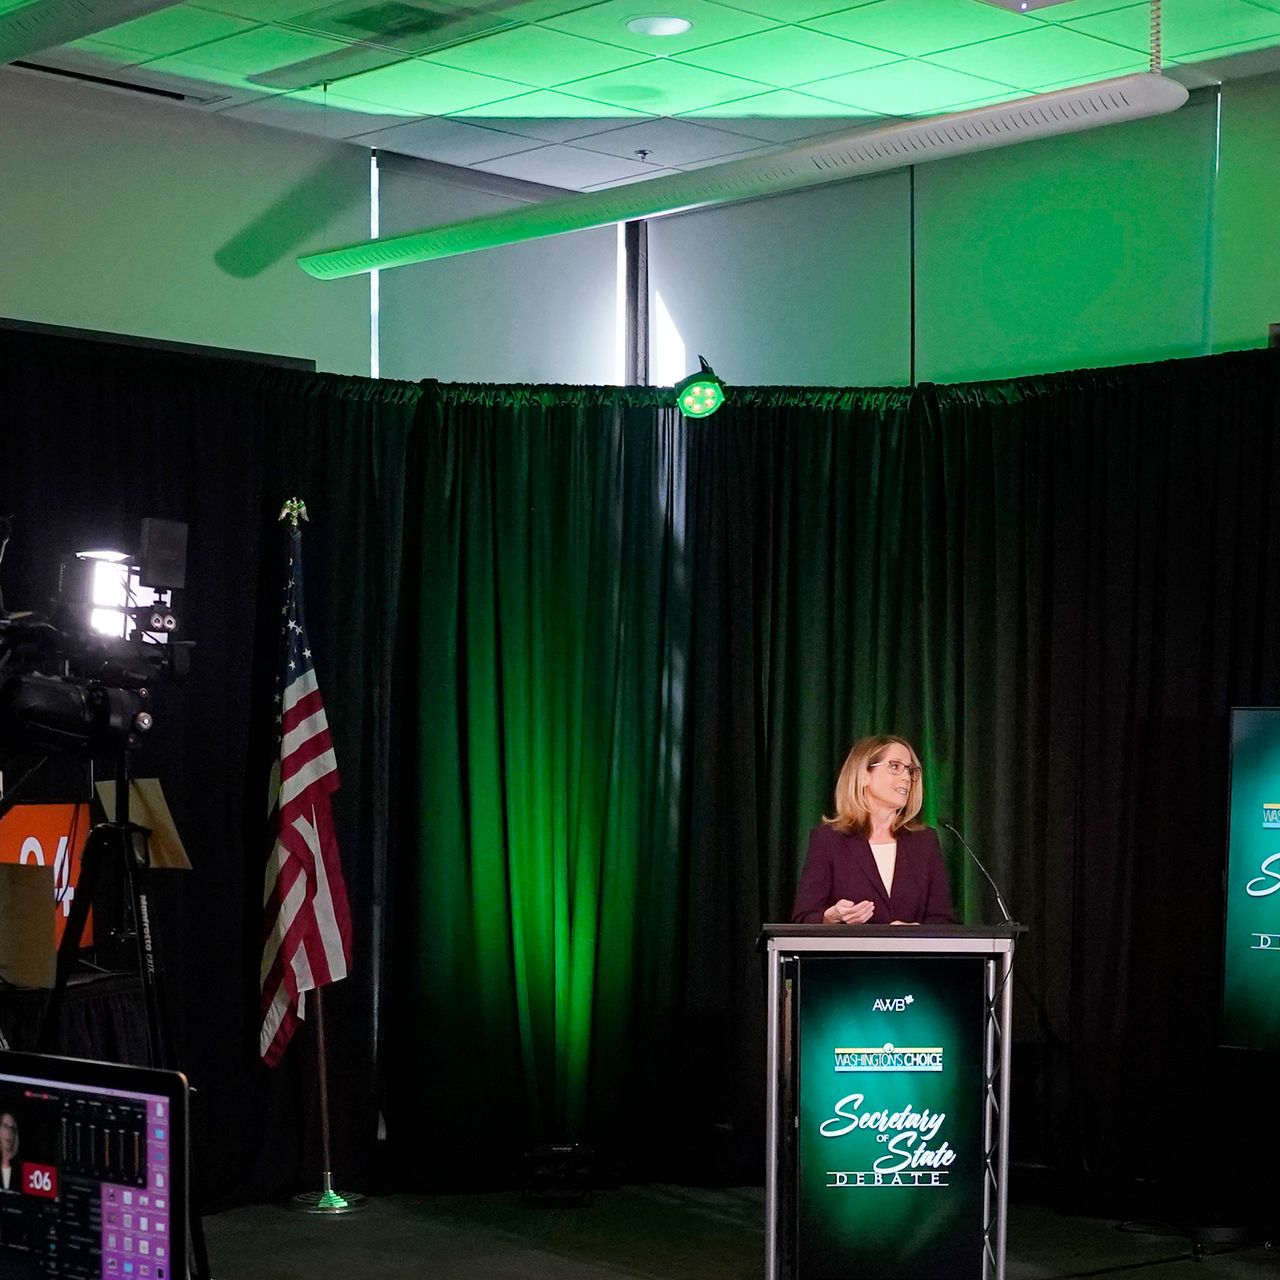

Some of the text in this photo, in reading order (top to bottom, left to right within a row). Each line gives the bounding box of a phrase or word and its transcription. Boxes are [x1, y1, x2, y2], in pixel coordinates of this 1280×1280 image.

[139, 894, 153, 951] Manfrotto
[872, 998, 906, 1011] AWB
[834, 1053, 943, 1066] WASHINGTON'S CHOICE
[819, 1093, 946, 1141] Secretary
[876, 1134, 889, 1143] OF
[873, 1131, 957, 1174] State
[29, 1169, 52, 1191] :06
[836, 1173, 941, 1185] DEBATE
